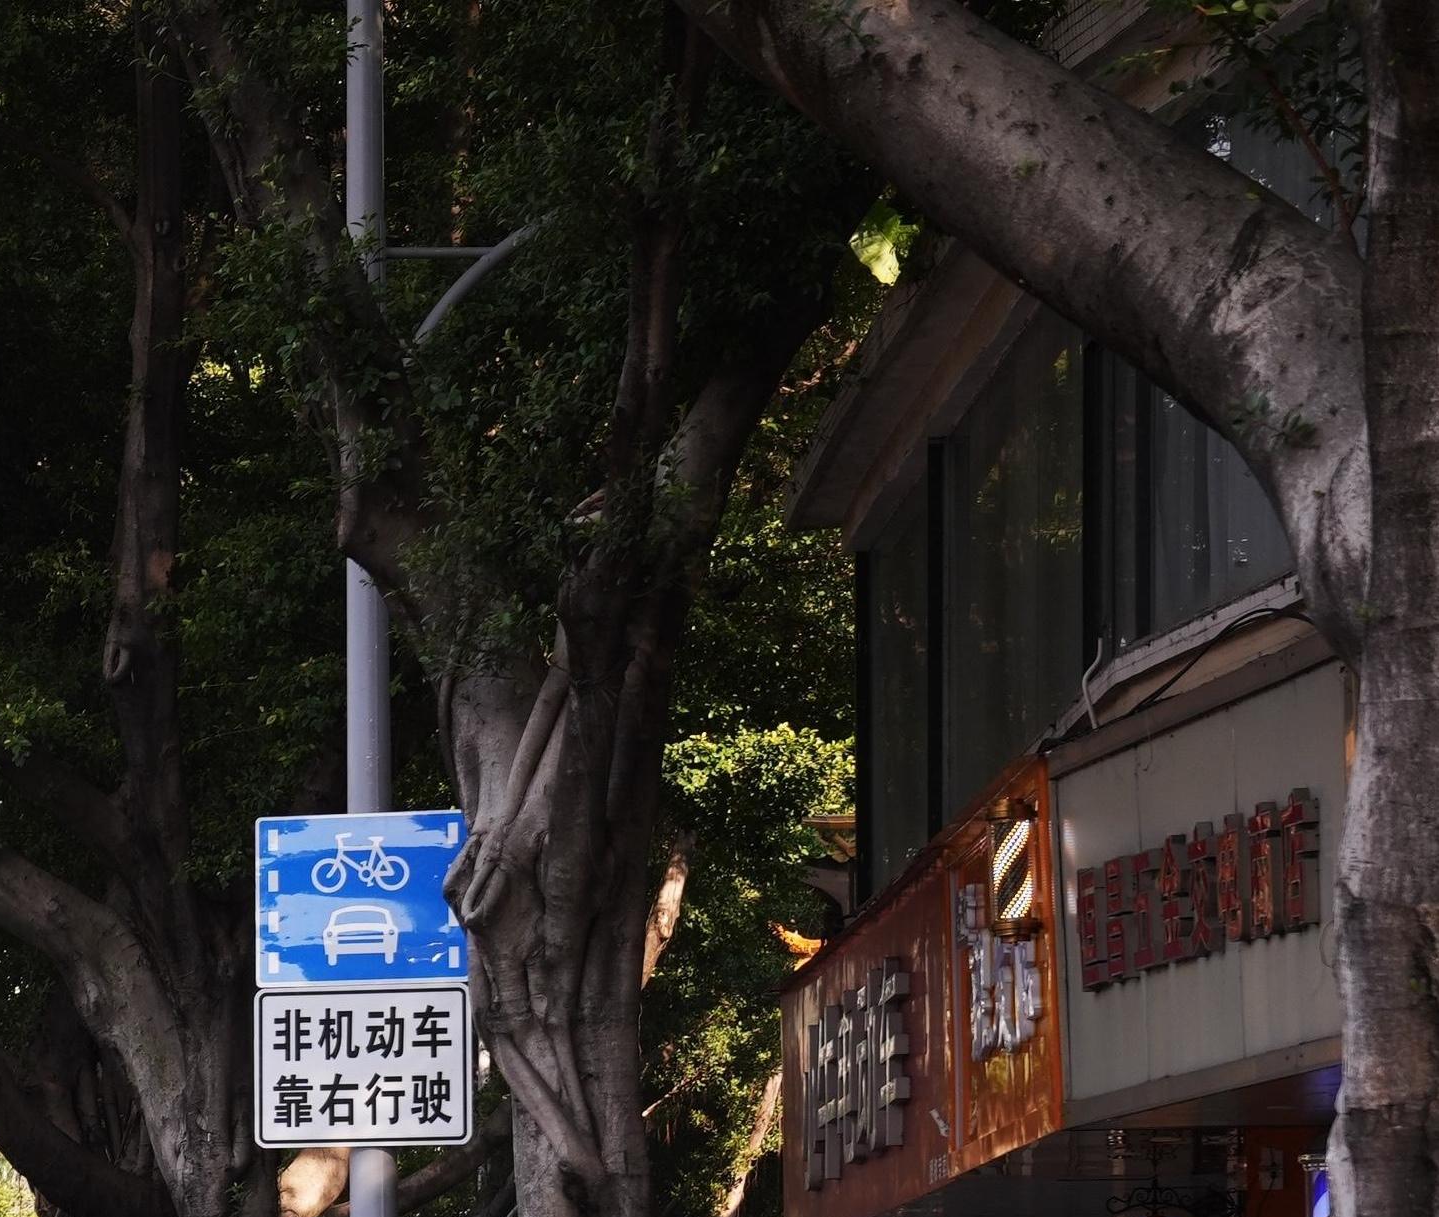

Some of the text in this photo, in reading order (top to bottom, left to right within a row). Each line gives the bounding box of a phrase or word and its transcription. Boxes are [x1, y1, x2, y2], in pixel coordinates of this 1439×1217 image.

[273, 1005, 452, 1061] 非机动车
[273, 1072, 452, 1127] 靠右行驶
